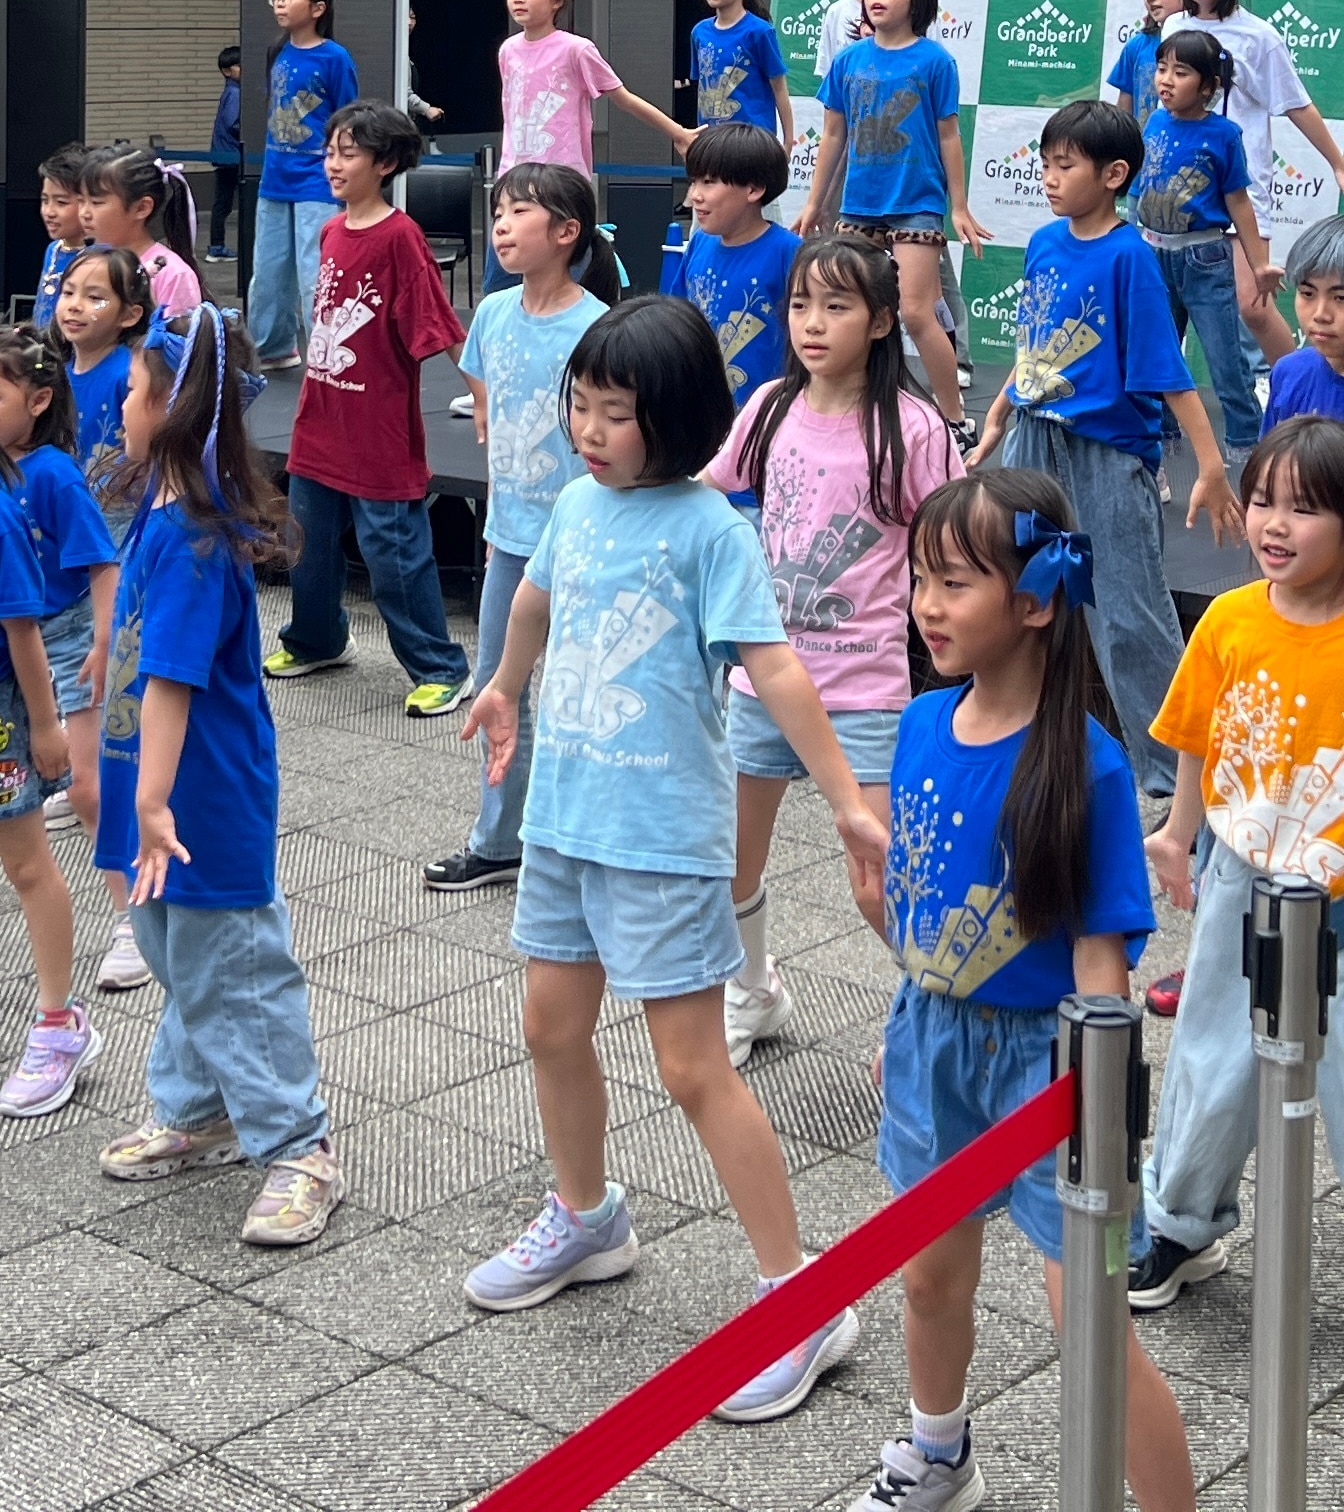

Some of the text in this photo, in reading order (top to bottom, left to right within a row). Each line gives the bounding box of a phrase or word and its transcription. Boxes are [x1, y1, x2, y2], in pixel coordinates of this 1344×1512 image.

[997, 17, 1092, 43] Grandberry
[807, 37, 820, 50] Pa
[1027, 44, 1057, 57] Park
[1008, 59, 1077, 70] Minami-machida
[793, 167, 816, 180] Par
[984, 156, 1044, 180] Grandb
[994, 197, 1051, 208] Minami-mach
[970, 297, 1020, 322] Grand
[1000, 322, 1017, 337] Pa
[340, 379, 365, 392] School
[795, 636, 879, 654] Dance School
[614, 748, 670, 768] School
